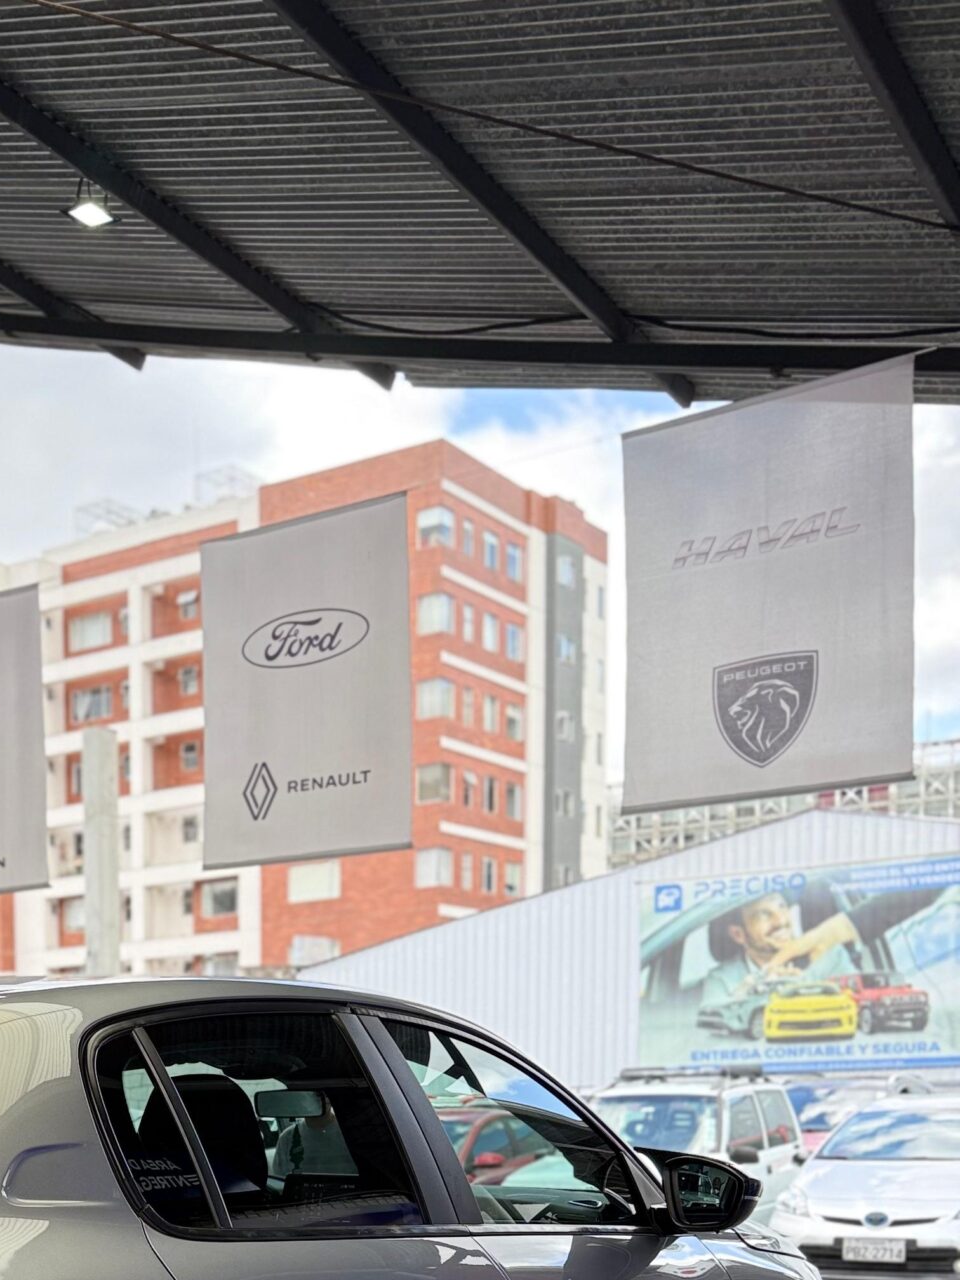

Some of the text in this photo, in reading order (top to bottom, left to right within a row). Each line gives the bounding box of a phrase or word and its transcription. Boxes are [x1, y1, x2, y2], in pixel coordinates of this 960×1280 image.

[672, 506, 862, 571] HAVAL
[264, 617, 344, 661] Ford
[722, 660, 809, 683] PEUGEOT
[287, 769, 372, 794] RENAULT
[693, 872, 807, 899] PRECISO
[690, 1040, 941, 1062] ENTREGA CONFIABLE Y SEGURA
